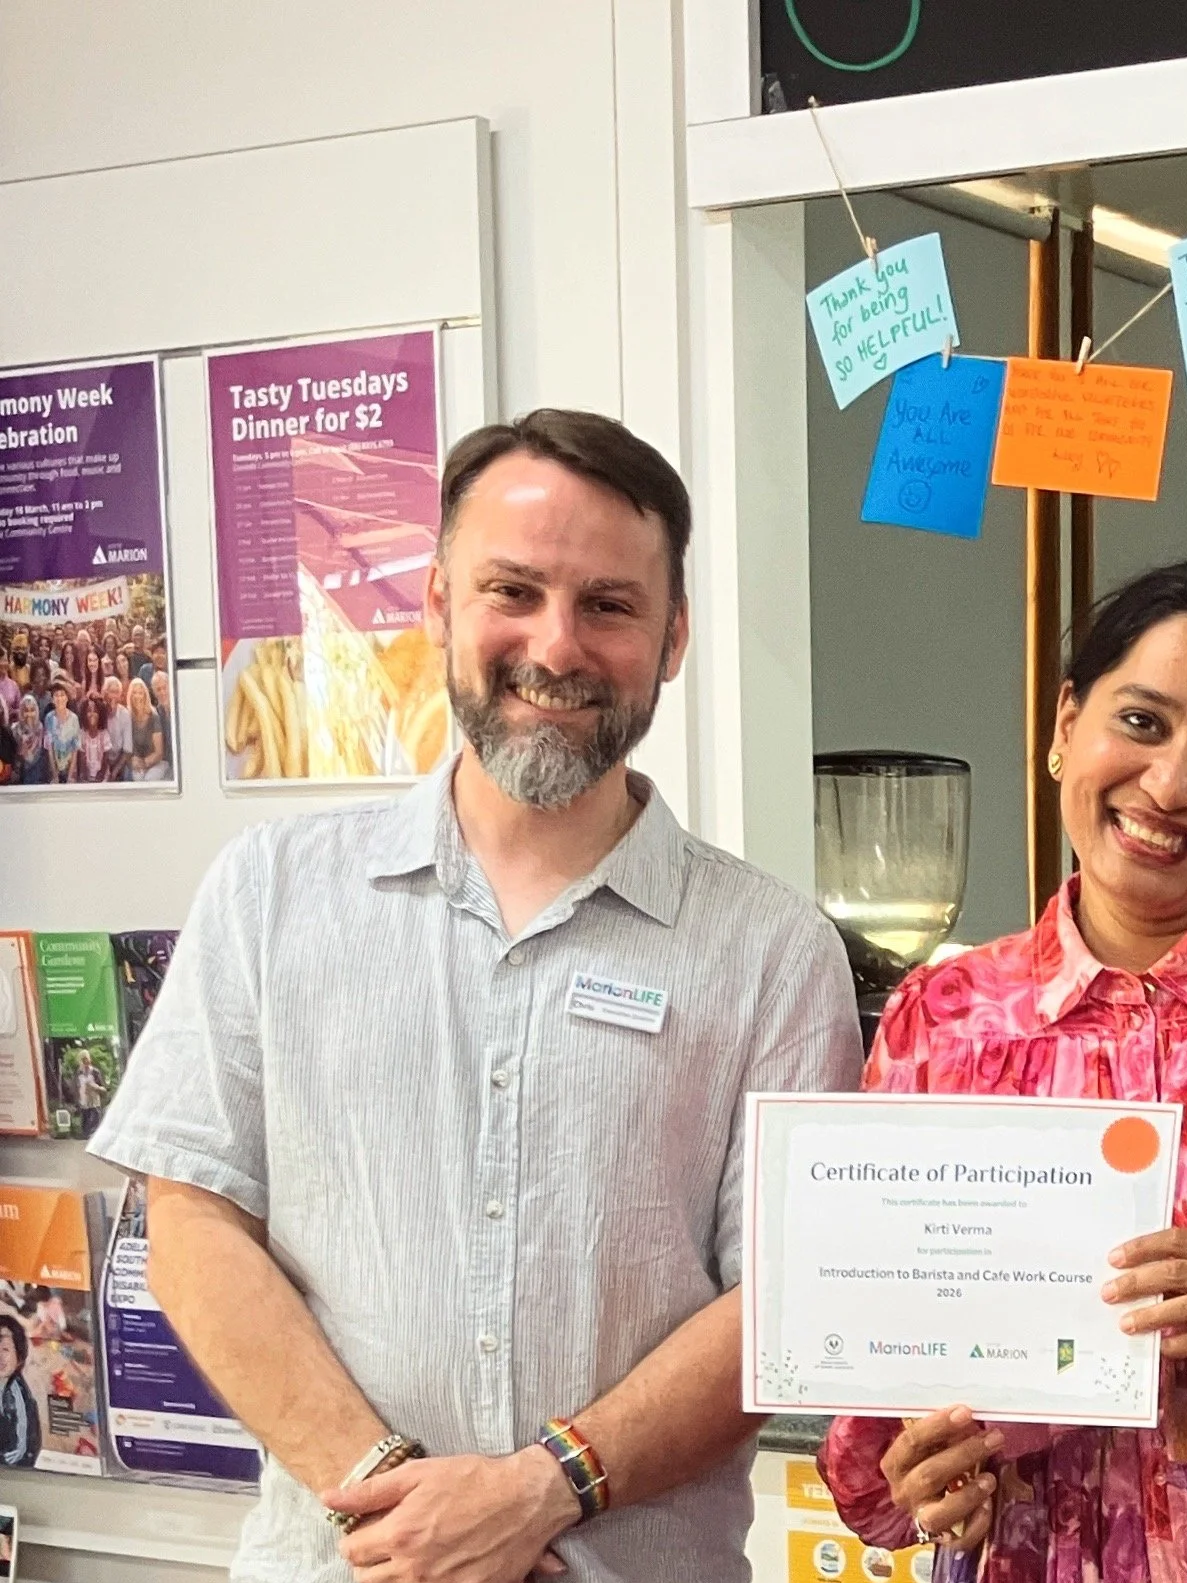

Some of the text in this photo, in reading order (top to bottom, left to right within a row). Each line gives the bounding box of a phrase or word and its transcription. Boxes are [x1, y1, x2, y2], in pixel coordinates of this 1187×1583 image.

[820, 259, 909, 318] Thank you
[832, 286, 909, 347] for being
[57, 383, 114, 410] Week
[229, 370, 409, 412] Tasty Tuesdays
[232, 403, 383, 442] Dinner for $2
[108, 548, 148, 562] MARION
[4, 586, 123, 616] HARMONY WEEK!
[811, 1161, 1092, 1188] Certificate of Participation
[881, 1197, 1028, 1208] This certificate has been awarded to
[924, 1223, 993, 1236] Kirti Verma
[819, 1267, 1093, 1283] Introduction to Barista and Cafe Work Course
[936, 1287, 963, 1298] 2026
[869, 1340, 947, 1356] MarionLIFE
[986, 1348, 1028, 1360] MARION
